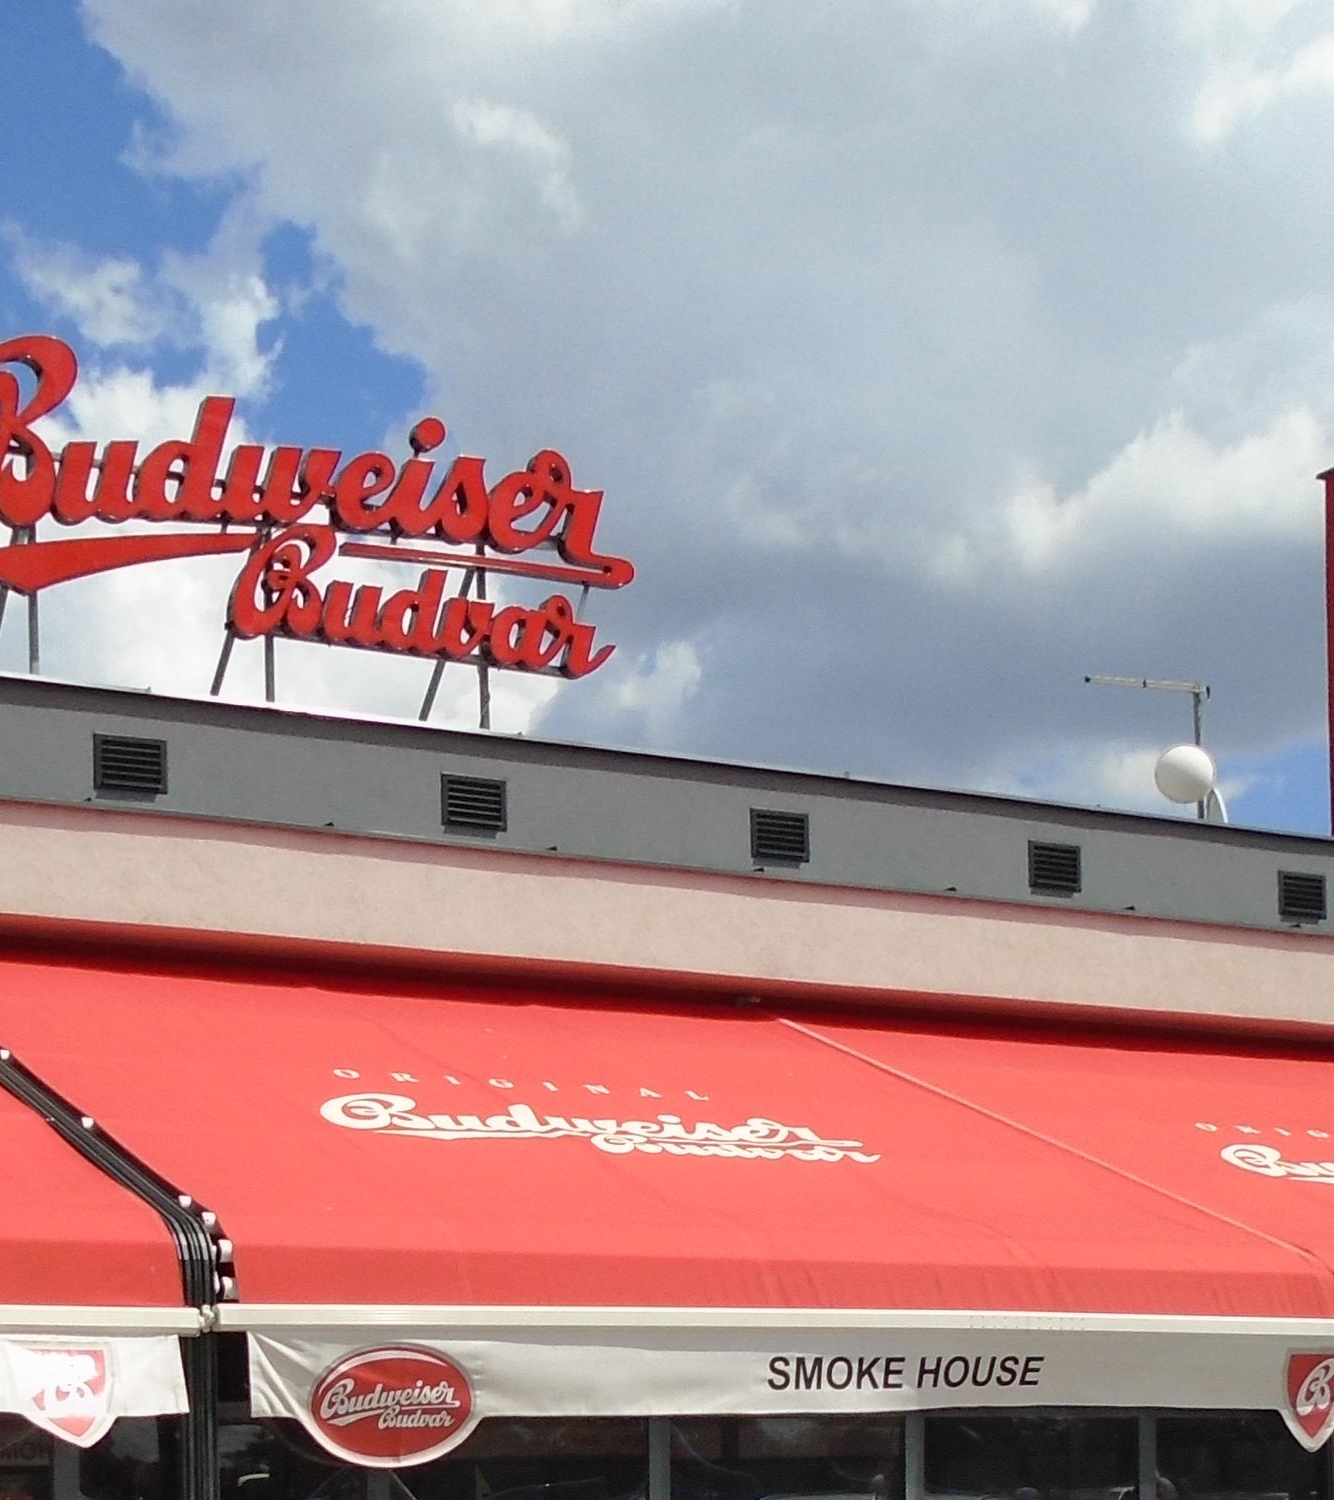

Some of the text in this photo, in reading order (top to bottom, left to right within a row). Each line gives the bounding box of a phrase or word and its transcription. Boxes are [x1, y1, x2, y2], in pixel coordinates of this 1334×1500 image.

[226, 524, 616, 679] Budvar
[332, 1067, 710, 1102] ORIGINAL
[320, 1092, 863, 1148] Budweiser
[767, 1355, 1045, 1390] SMOKE HOUSE
[320, 1378, 461, 1422] Budweiser
[378, 1404, 455, 1429] Budvar
